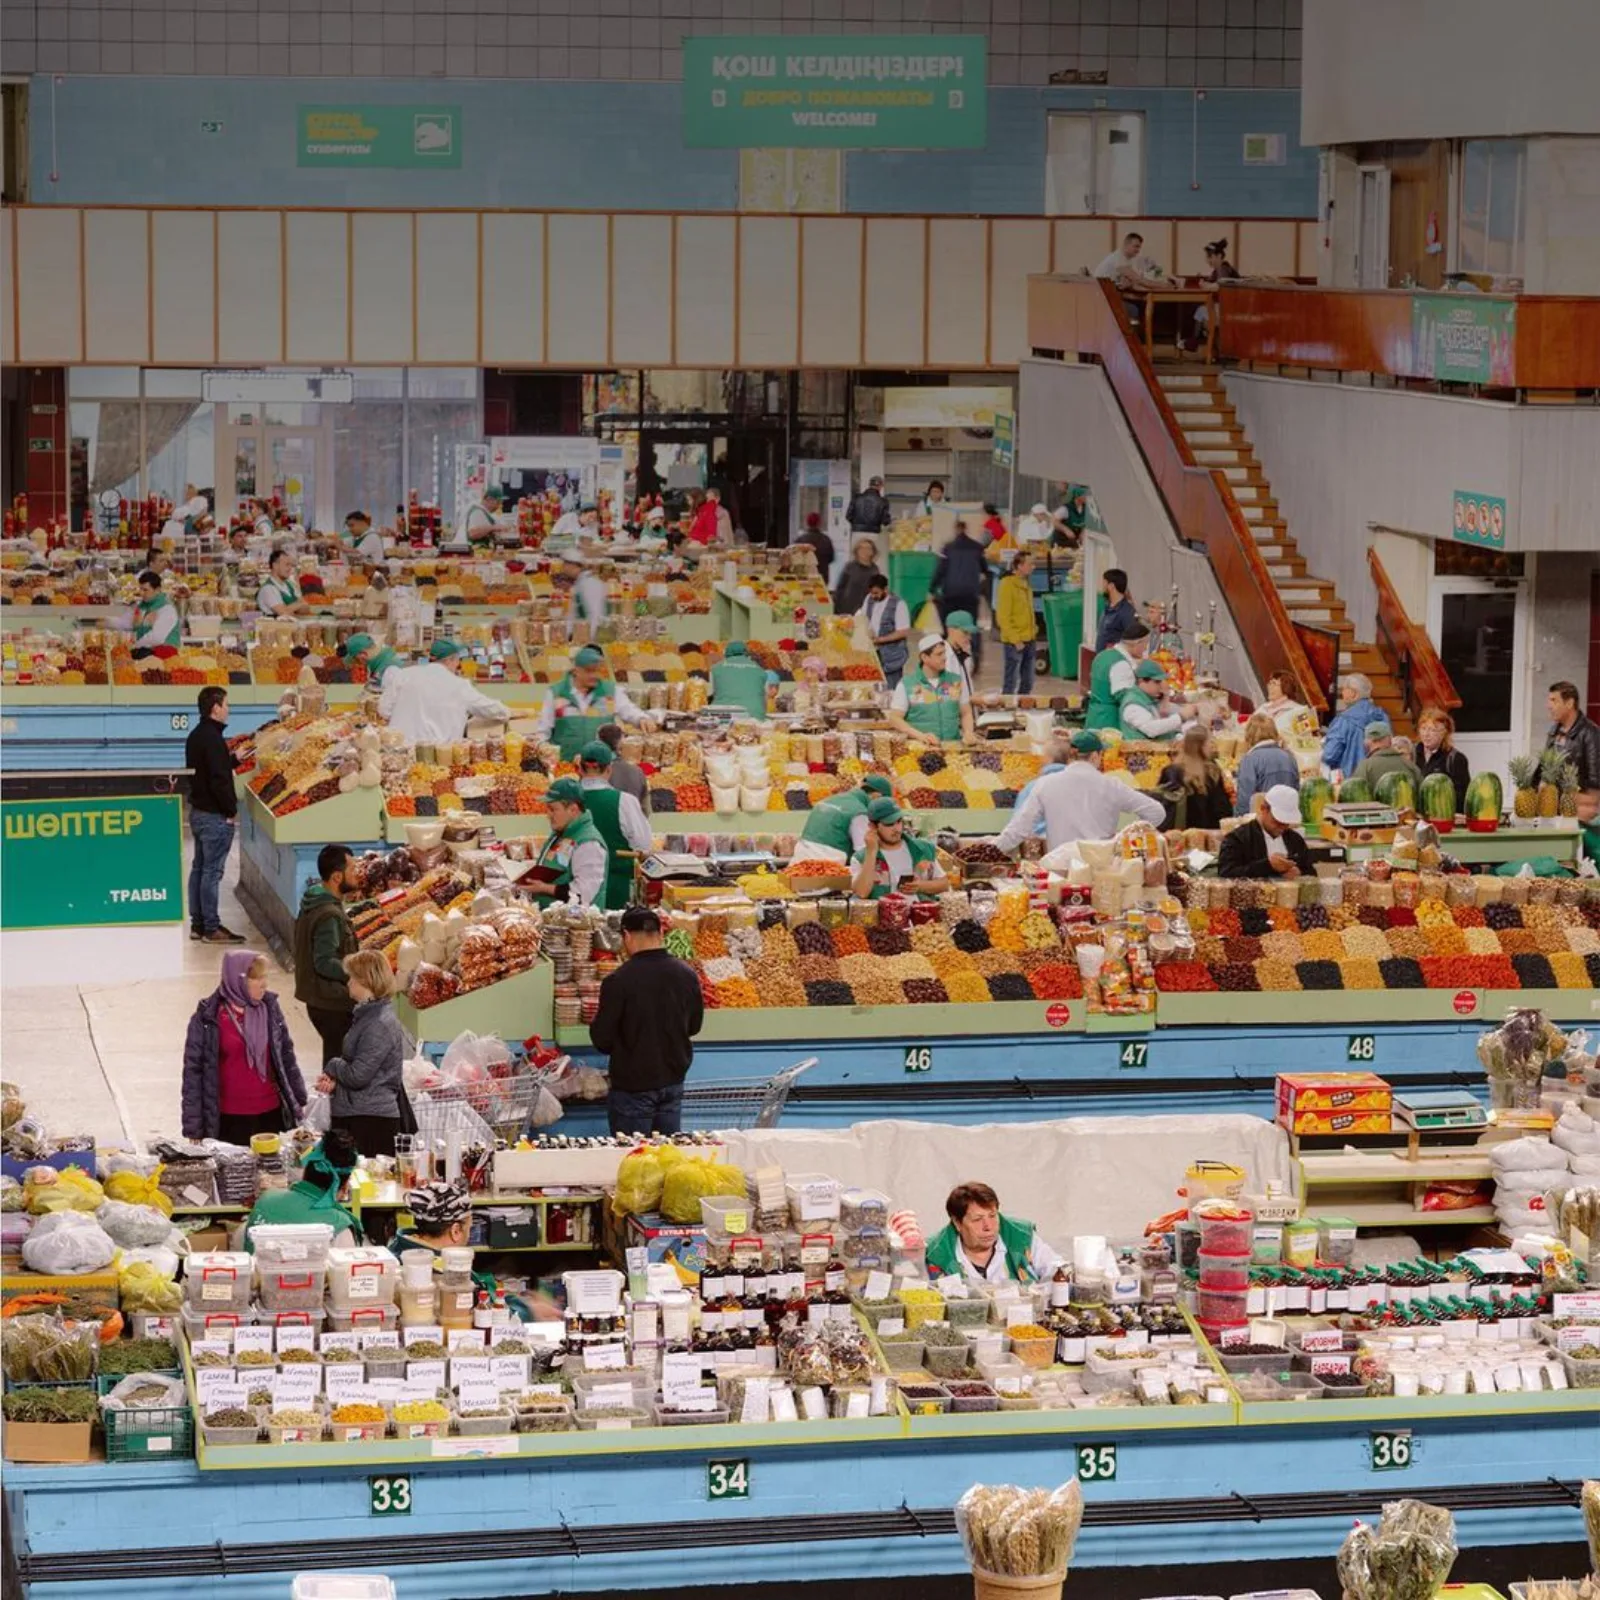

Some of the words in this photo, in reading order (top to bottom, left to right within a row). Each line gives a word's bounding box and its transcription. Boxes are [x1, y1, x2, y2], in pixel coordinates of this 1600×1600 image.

[712, 56, 776, 80] ҚОШ
[172, 715, 189, 729] 66
[5, 810, 143, 839] ШӨПТЕР
[109, 888, 167, 904] ТРАВЫ
[905, 1048, 931, 1070] 46
[1122, 1043, 1147, 1065] 47
[1349, 1037, 1374, 1058] 48
[1079, 1446, 1116, 1479] 35
[1374, 1435, 1409, 1466] 36
[709, 1462, 749, 1496] 34
[372, 1478, 412, 1512] 33
